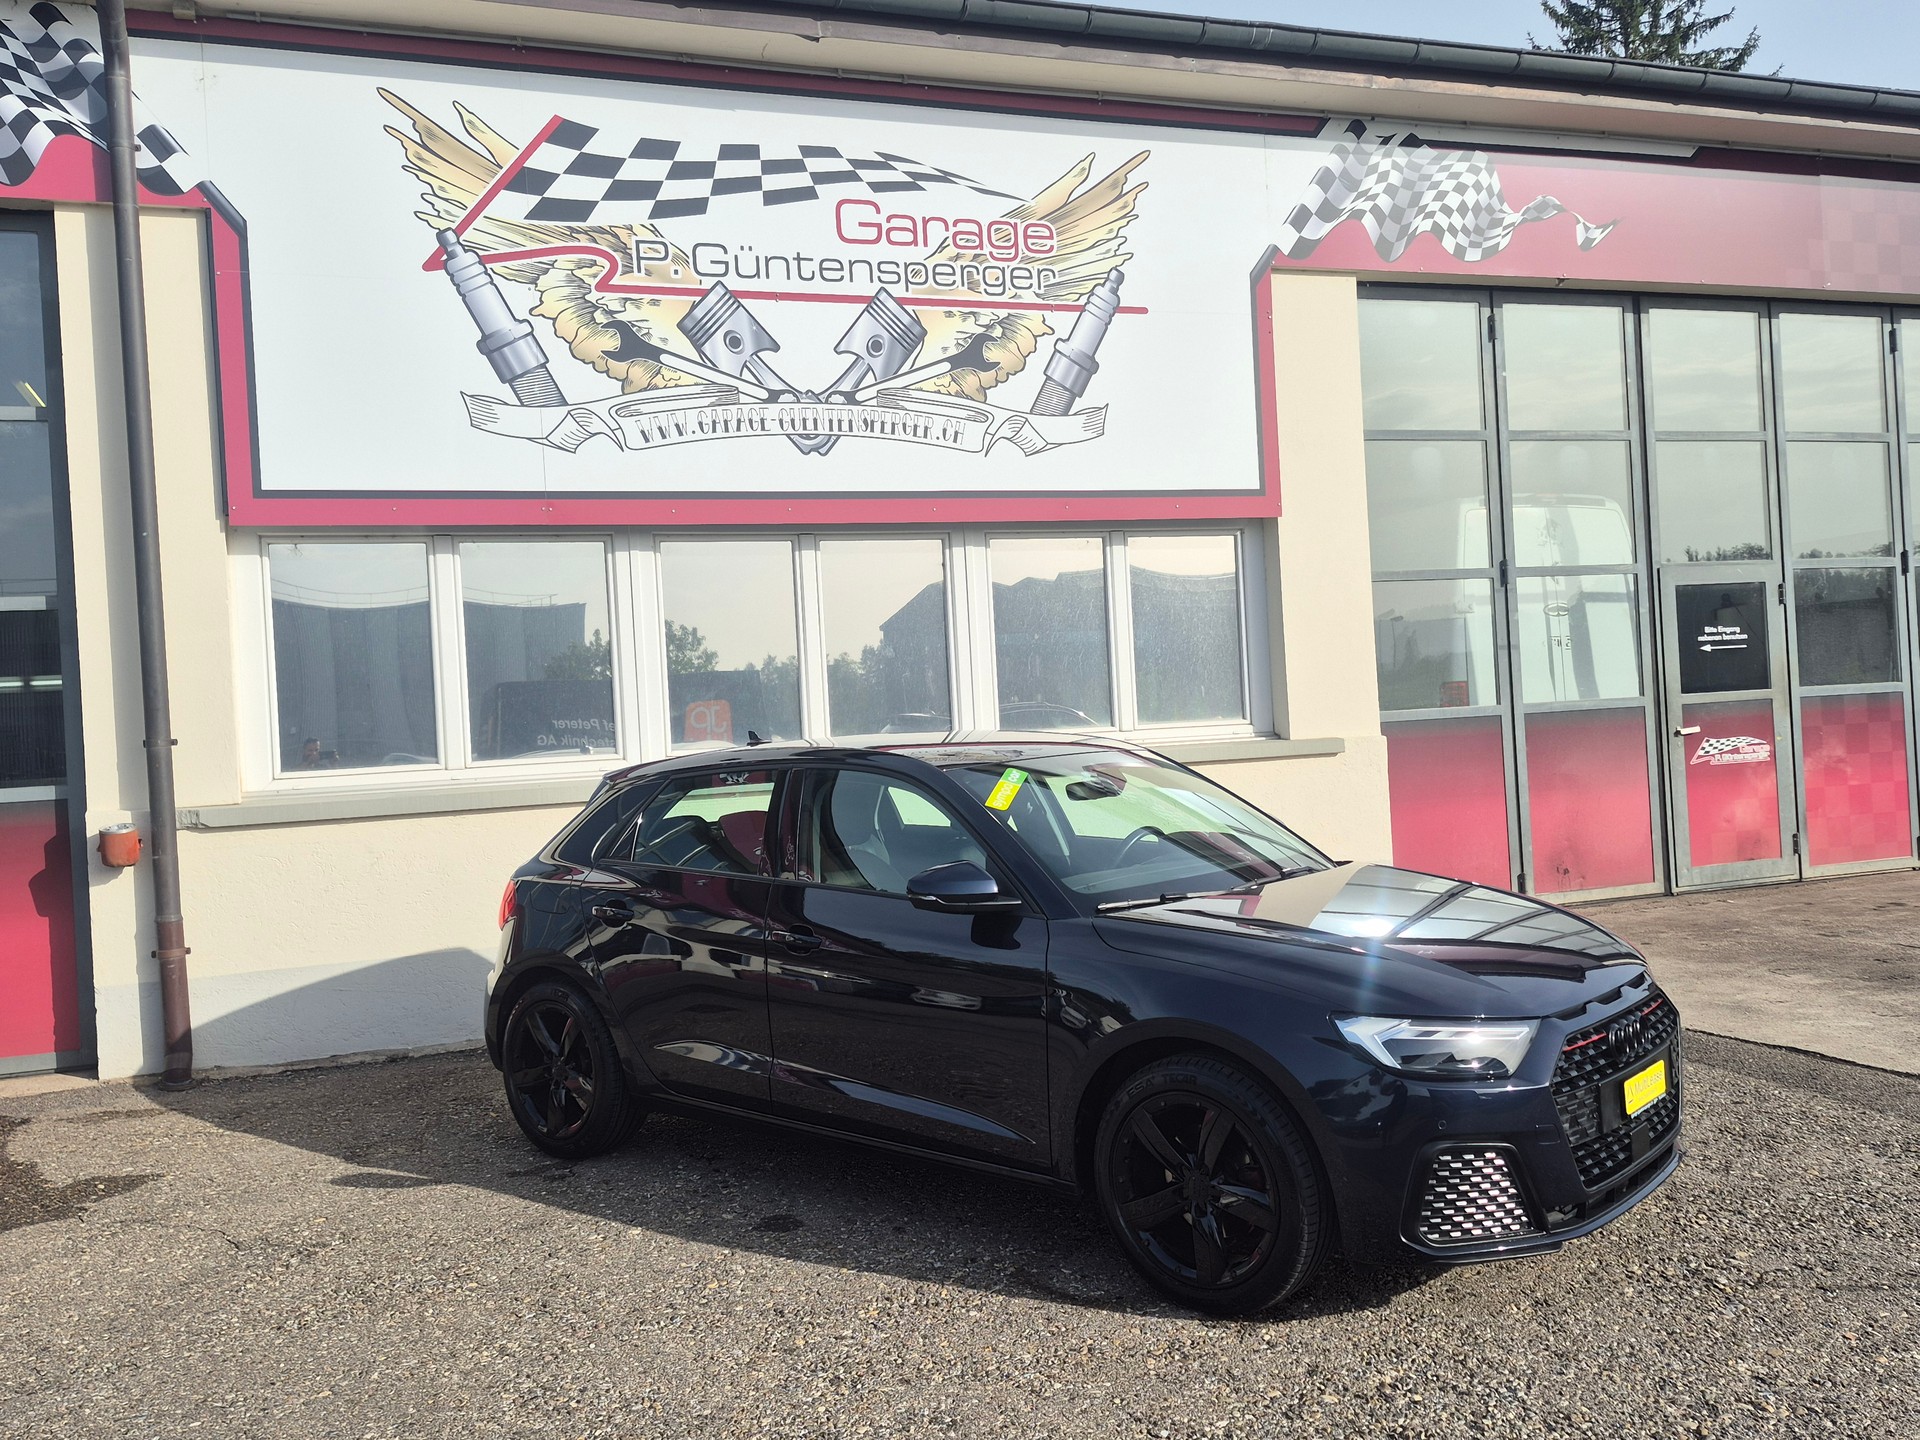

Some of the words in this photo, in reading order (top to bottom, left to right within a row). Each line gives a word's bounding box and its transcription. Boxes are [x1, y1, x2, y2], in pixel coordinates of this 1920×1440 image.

[834, 198, 1056, 263] Garage
[635, 240, 680, 276] P.
[691, 242, 1057, 297] Güntensperger
[635, 407, 965, 445] WWW.GARAGE-GUENTENSPERGER.CH
